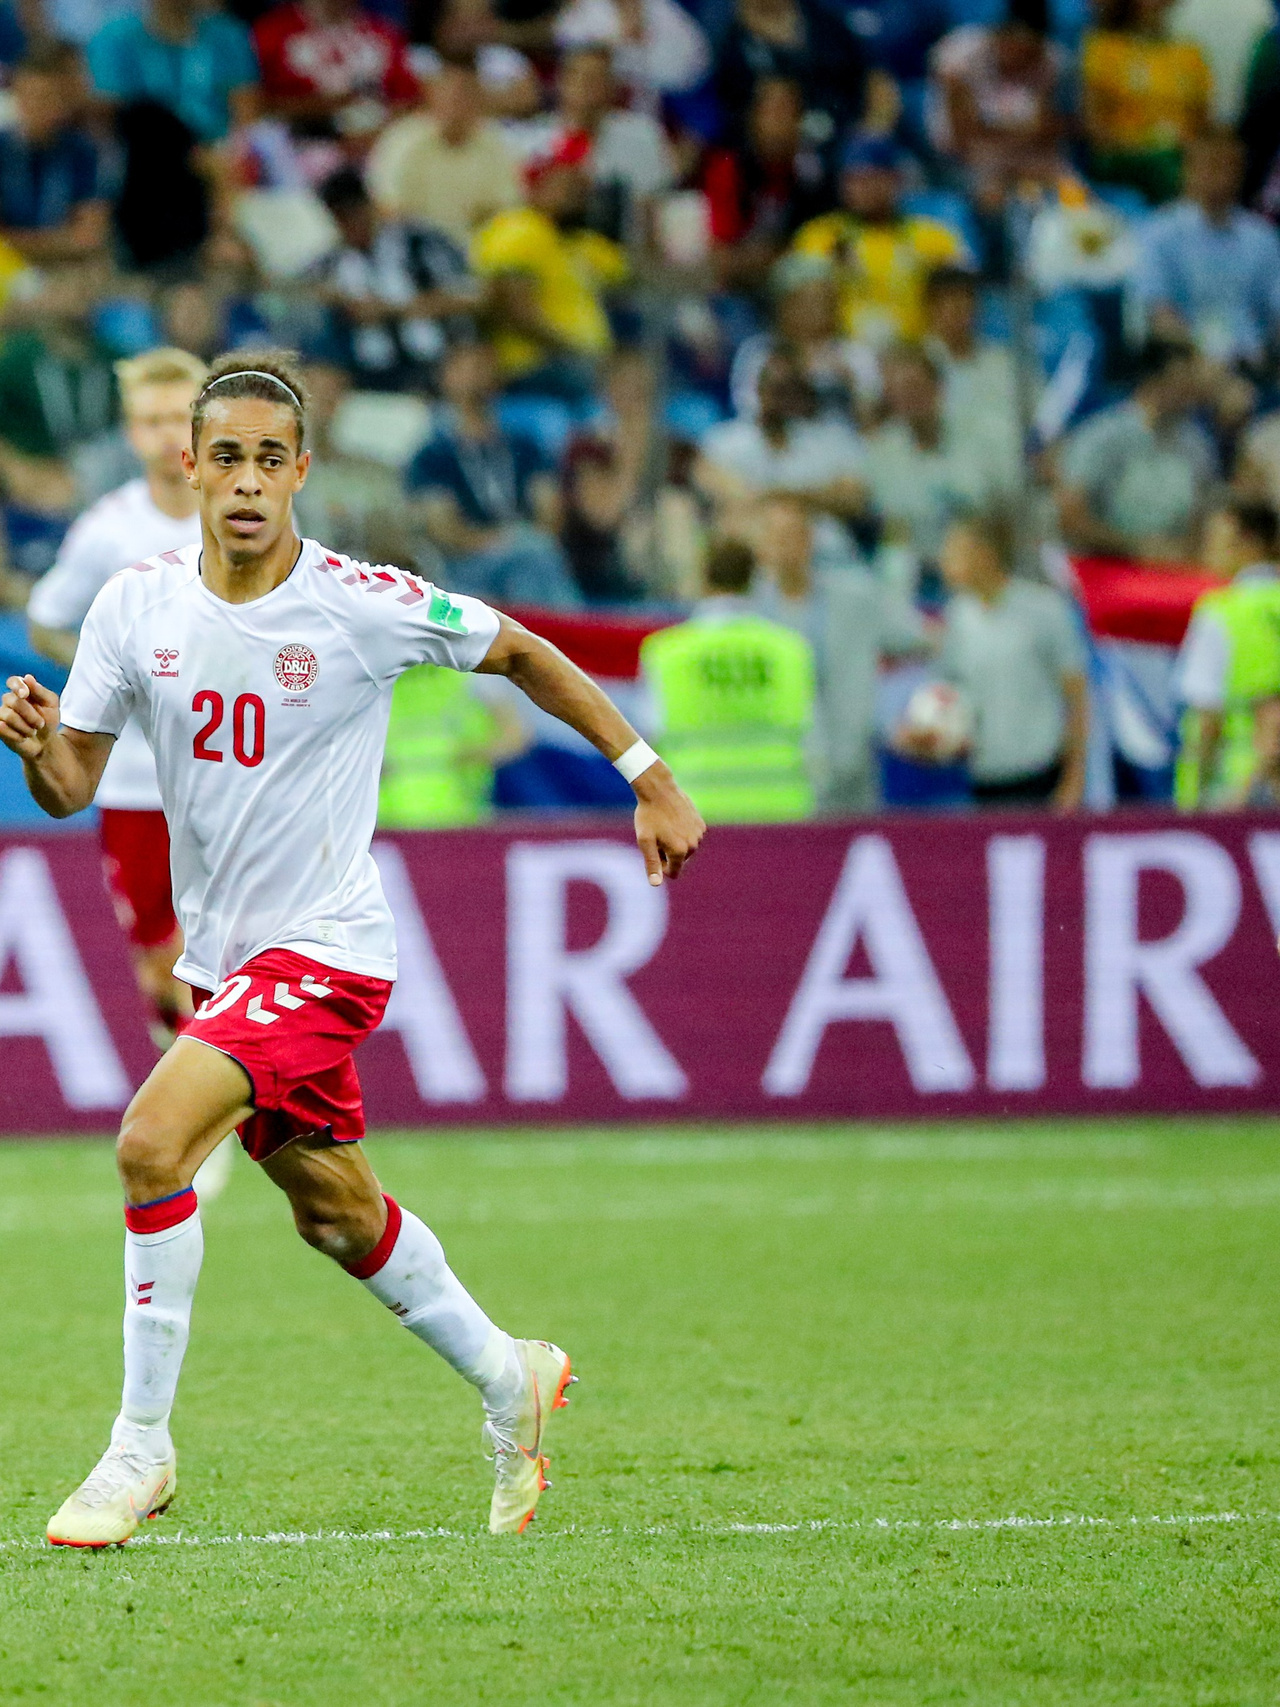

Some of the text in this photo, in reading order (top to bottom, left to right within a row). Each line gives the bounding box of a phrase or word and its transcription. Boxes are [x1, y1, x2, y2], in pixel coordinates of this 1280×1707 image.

[151, 669, 179, 677] hummel
[283, 659, 309, 674] DBU
[192, 689, 265, 768] 20
